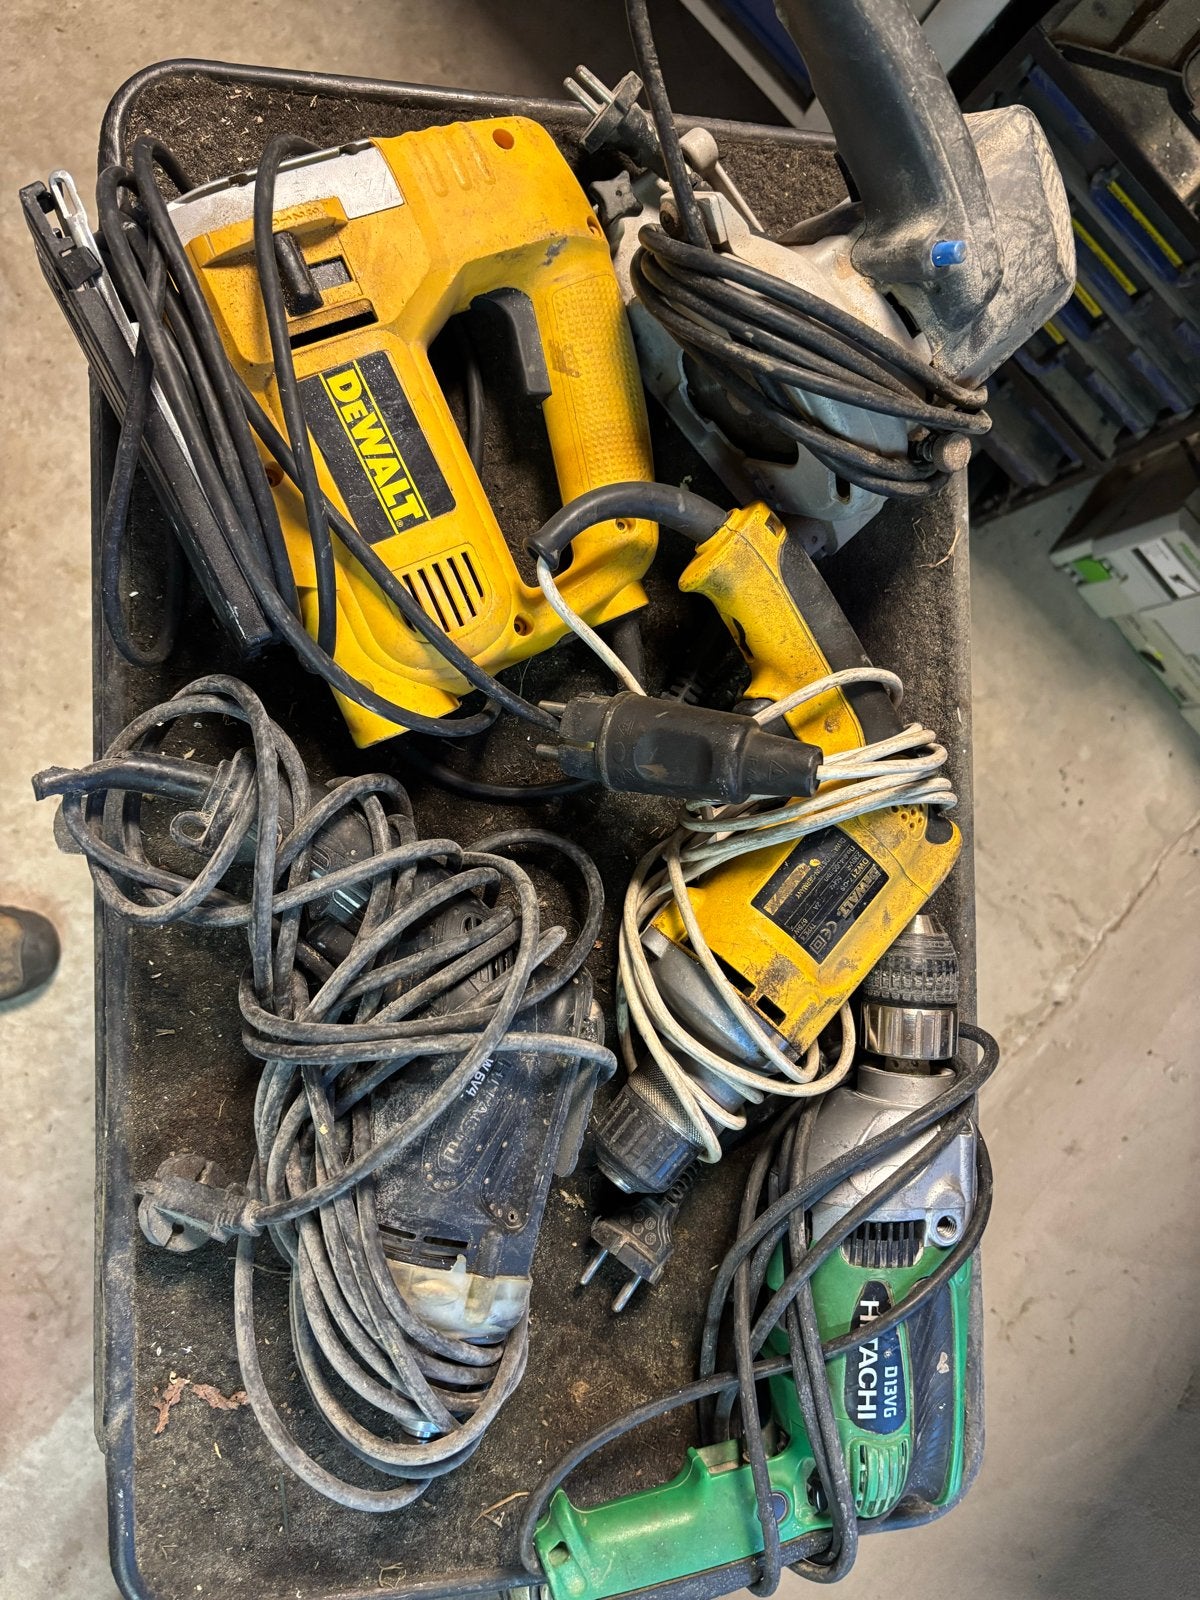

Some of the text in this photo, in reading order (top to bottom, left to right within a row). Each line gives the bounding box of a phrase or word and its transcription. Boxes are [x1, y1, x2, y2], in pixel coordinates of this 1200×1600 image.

[465, 1071, 485, 1098] 6V4
[857, 1300, 880, 1420] HTACHI
[884, 1366, 898, 1418] D13VG
